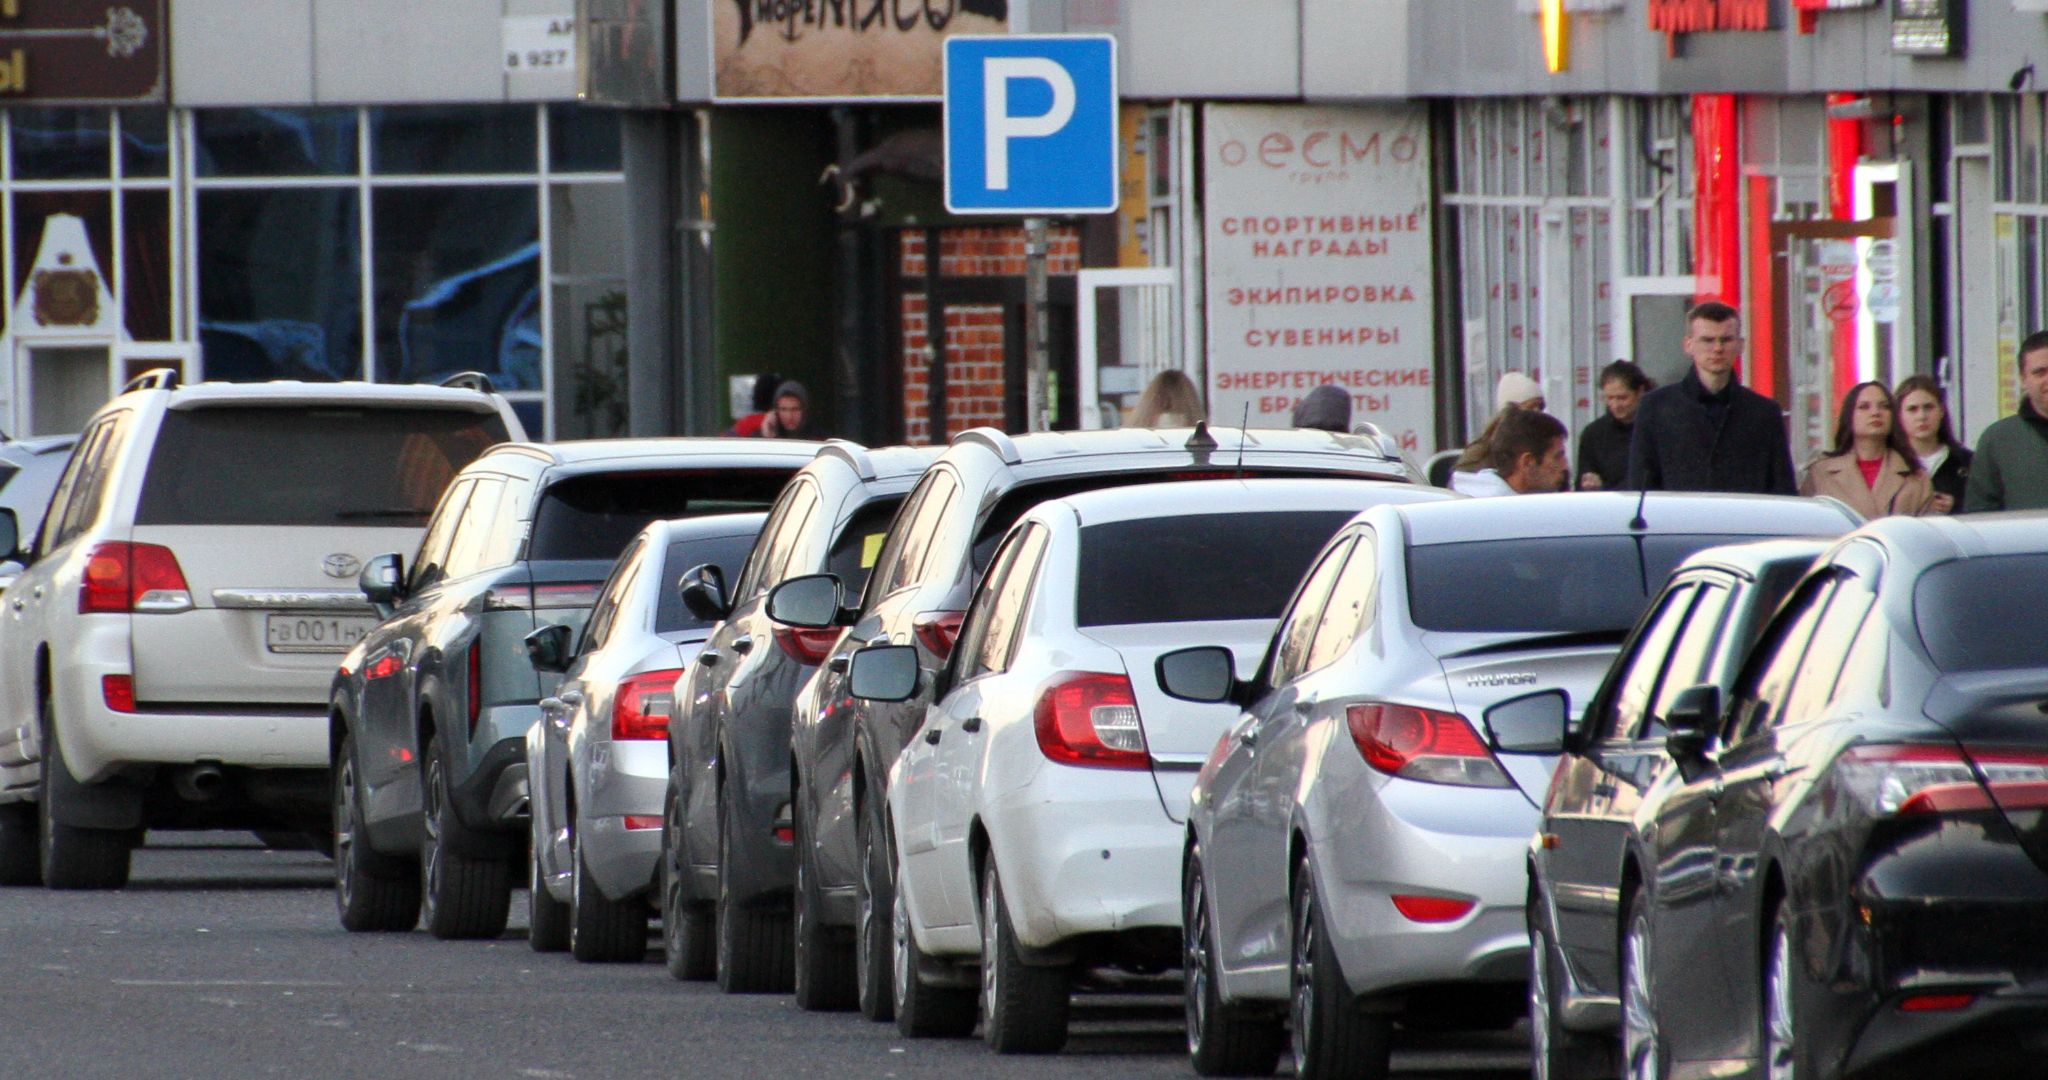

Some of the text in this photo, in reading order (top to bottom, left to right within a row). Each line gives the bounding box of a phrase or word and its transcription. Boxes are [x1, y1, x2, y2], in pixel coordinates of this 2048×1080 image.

[528, 50, 567, 66] 927
[984, 57, 1076, 190] P
[1221, 213, 1420, 235] СПОРТИВНЫЕ
[1253, 237, 1388, 257] НАГРАДЫ
[1228, 285, 1415, 306] ЭКИПИРОВКА
[1245, 327, 1400, 347] СУВЕНИРЫ
[1216, 368, 1431, 390] ЭНЕРГЕТИЧЕСКИЕ
[1259, 395, 1391, 413] БРТЫ
[1467, 672, 1537, 687] HYUNDAI
